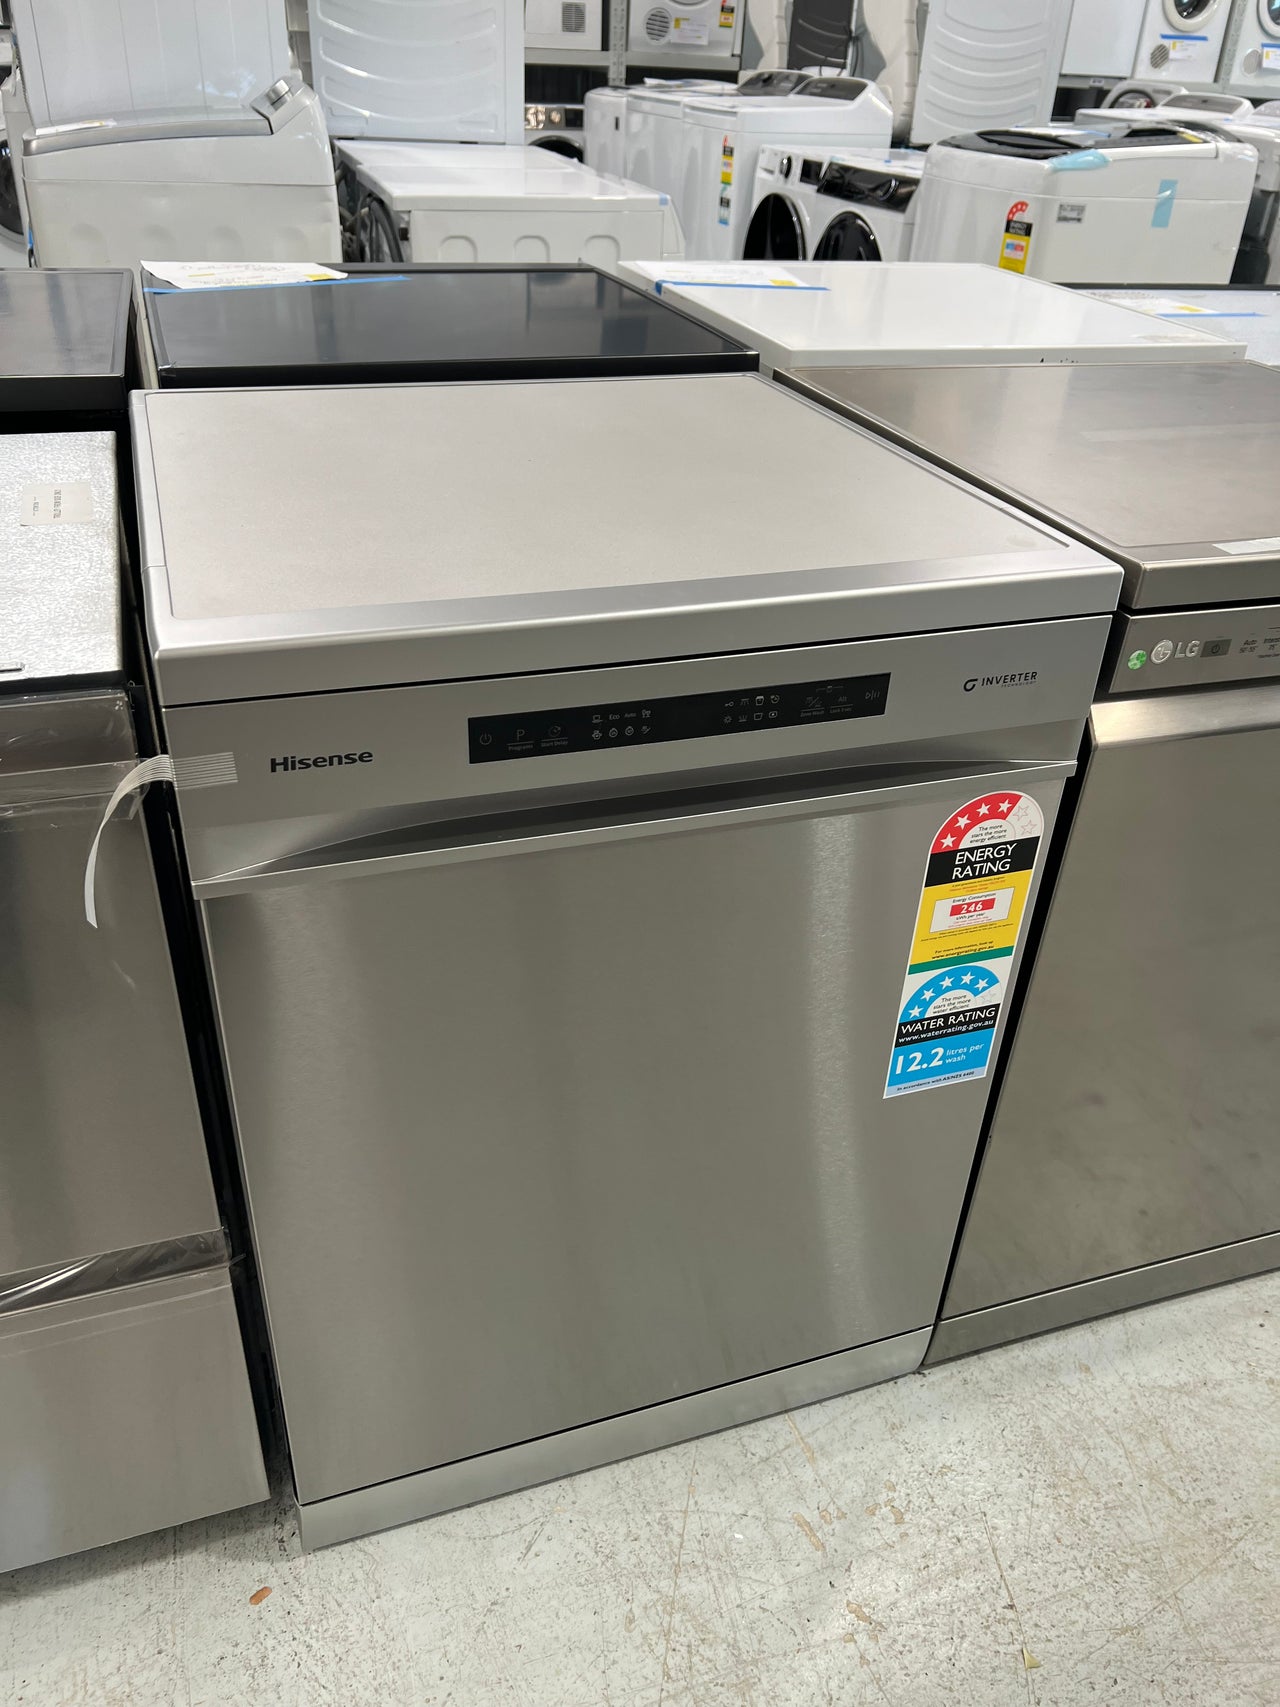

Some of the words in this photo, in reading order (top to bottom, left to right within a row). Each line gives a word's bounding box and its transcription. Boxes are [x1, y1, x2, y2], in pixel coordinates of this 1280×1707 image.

[1174, 640, 1200, 659] LG
[981, 671, 1038, 687] INVERTER
[608, 712, 621, 721] Eco
[270, 751, 374, 773] Hisense
[954, 842, 1018, 865] ENERGY
[952, 859, 1012, 880] RATING
[952, 896, 967, 904] Energy
[967, 893, 997, 902] Consumption
[960, 901, 983, 914] 246
[900, 1017, 945, 1034] WATER
[948, 1007, 996, 1026] RATING
[898, 1019, 994, 1043] www.waterrating.gov.au
[895, 1047, 945, 1075] 12.2
[946, 1047, 968, 1057] litres
[969, 1043, 985, 1053] per
[945, 1054, 966, 1064] wash
[903, 1081, 931, 1090] accordance
